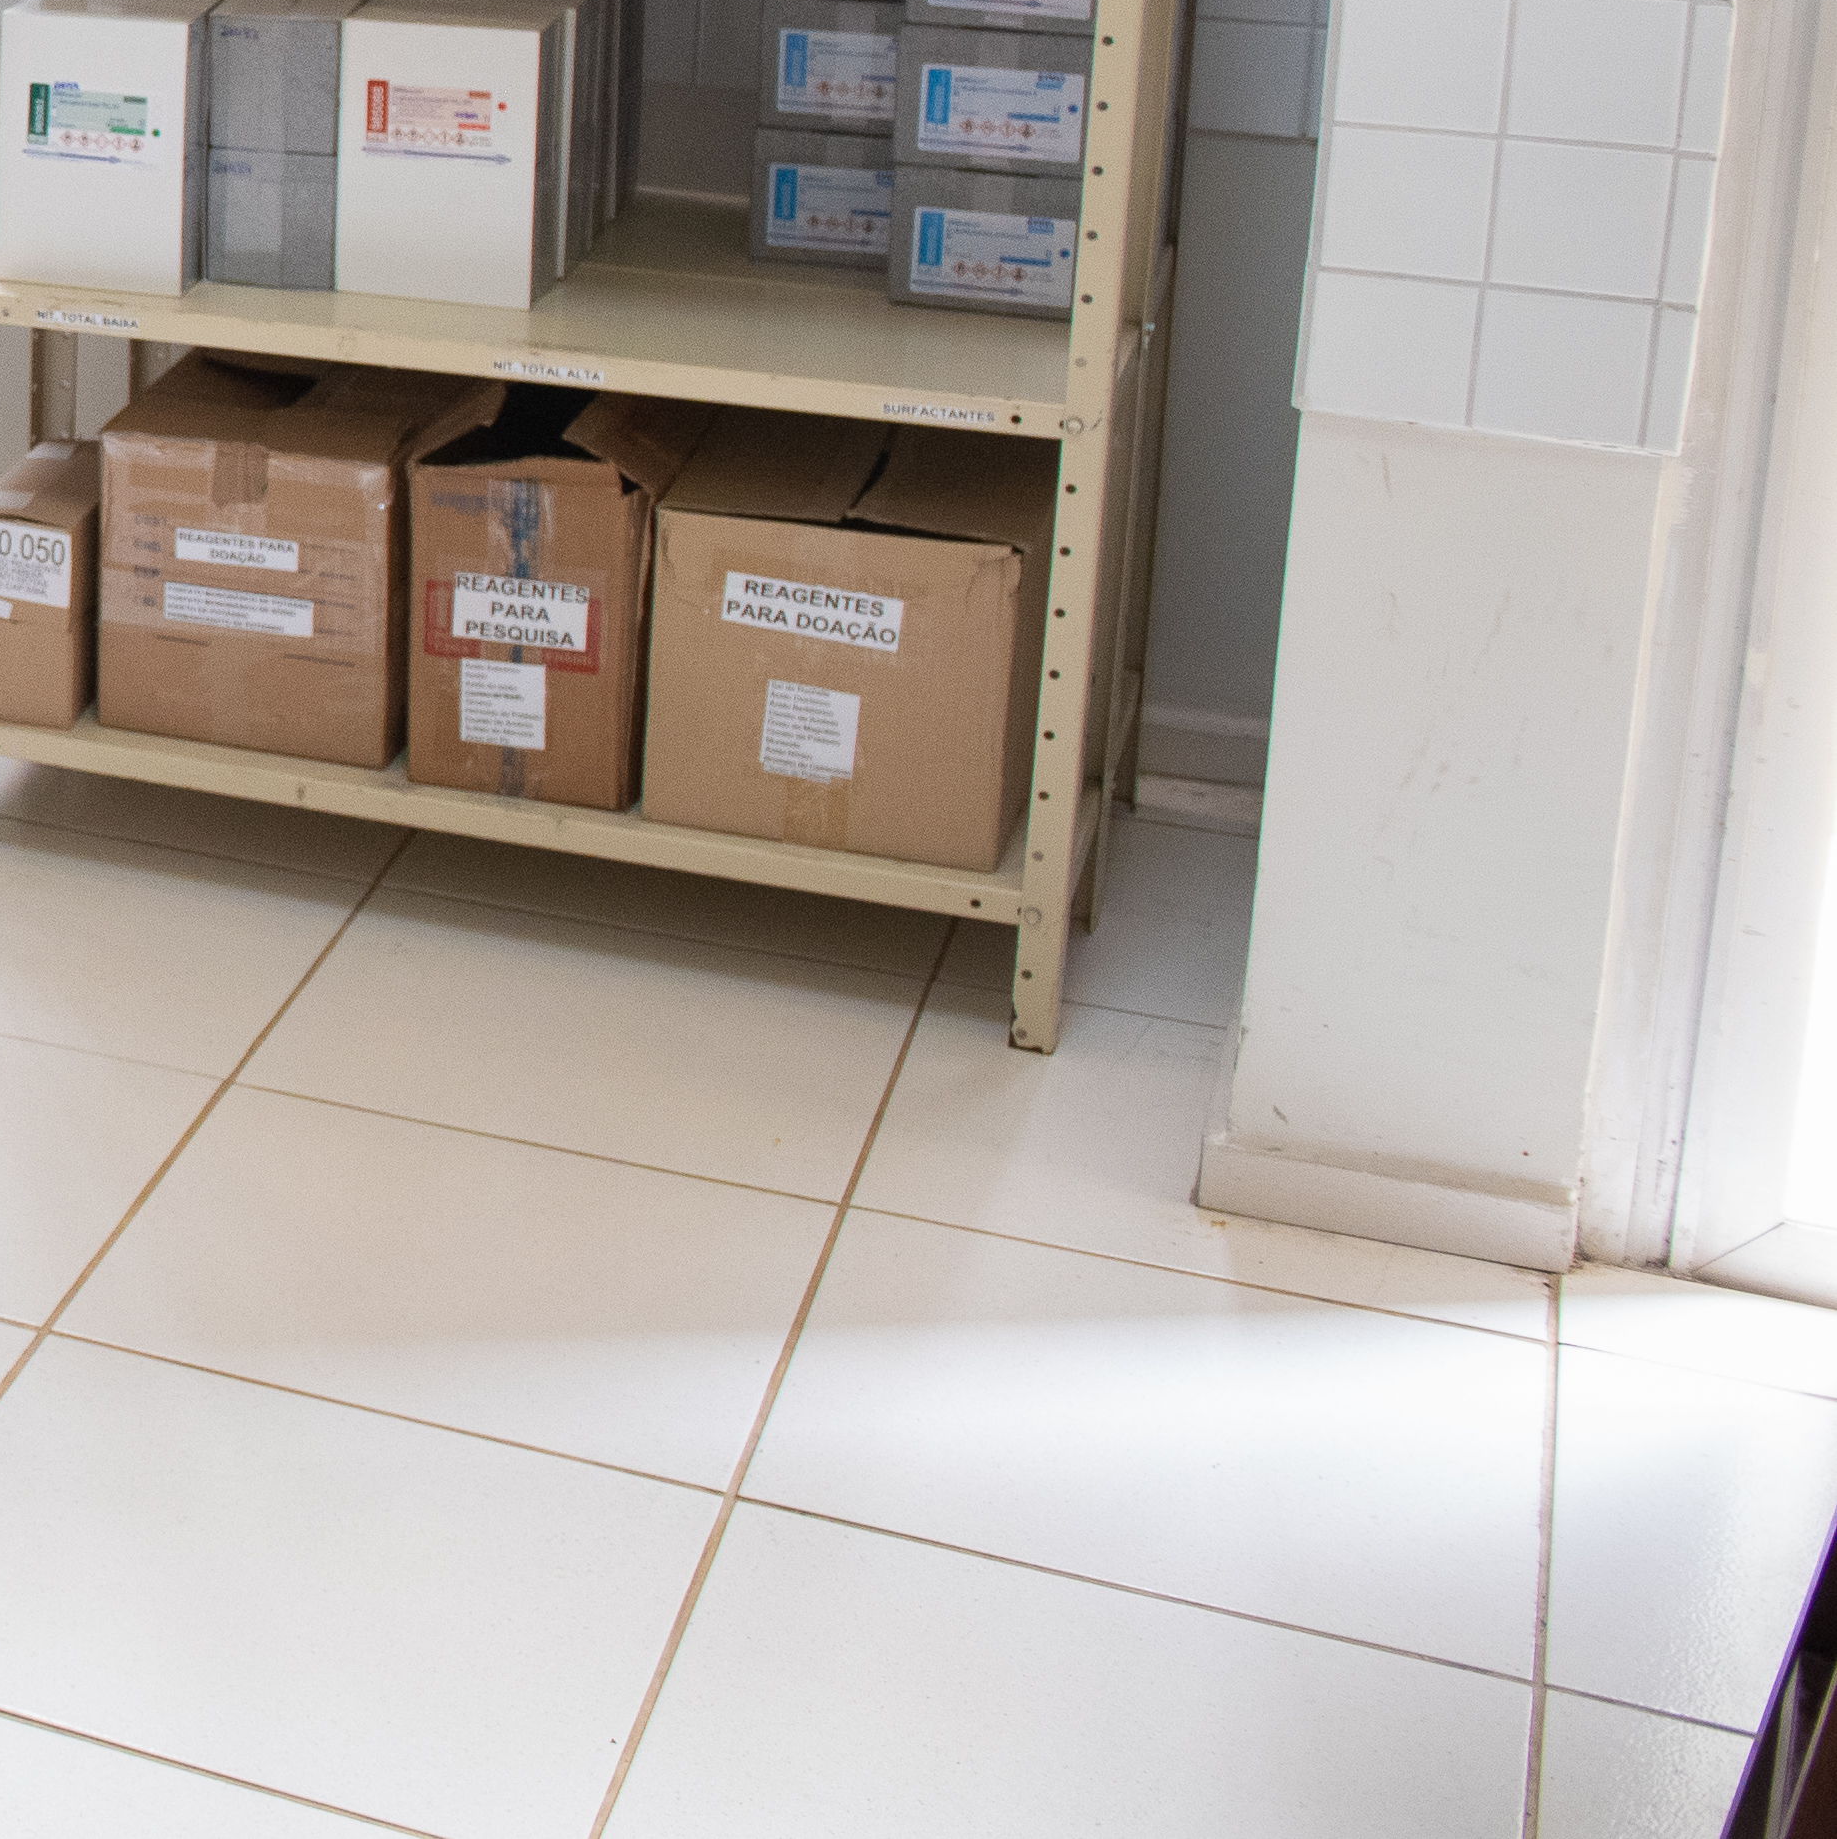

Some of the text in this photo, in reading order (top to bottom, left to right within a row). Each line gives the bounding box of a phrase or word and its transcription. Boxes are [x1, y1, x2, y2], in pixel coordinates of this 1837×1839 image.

[882, 402, 996, 423] SURFACTANTES
[456, 574, 589, 605] REAGENTES
[744, 579, 886, 618] REAGENTES
[490, 600, 551, 624] PARA
[726, 599, 897, 645] PARA DOAÇÃO
[465, 620, 575, 648] PESQUISA
